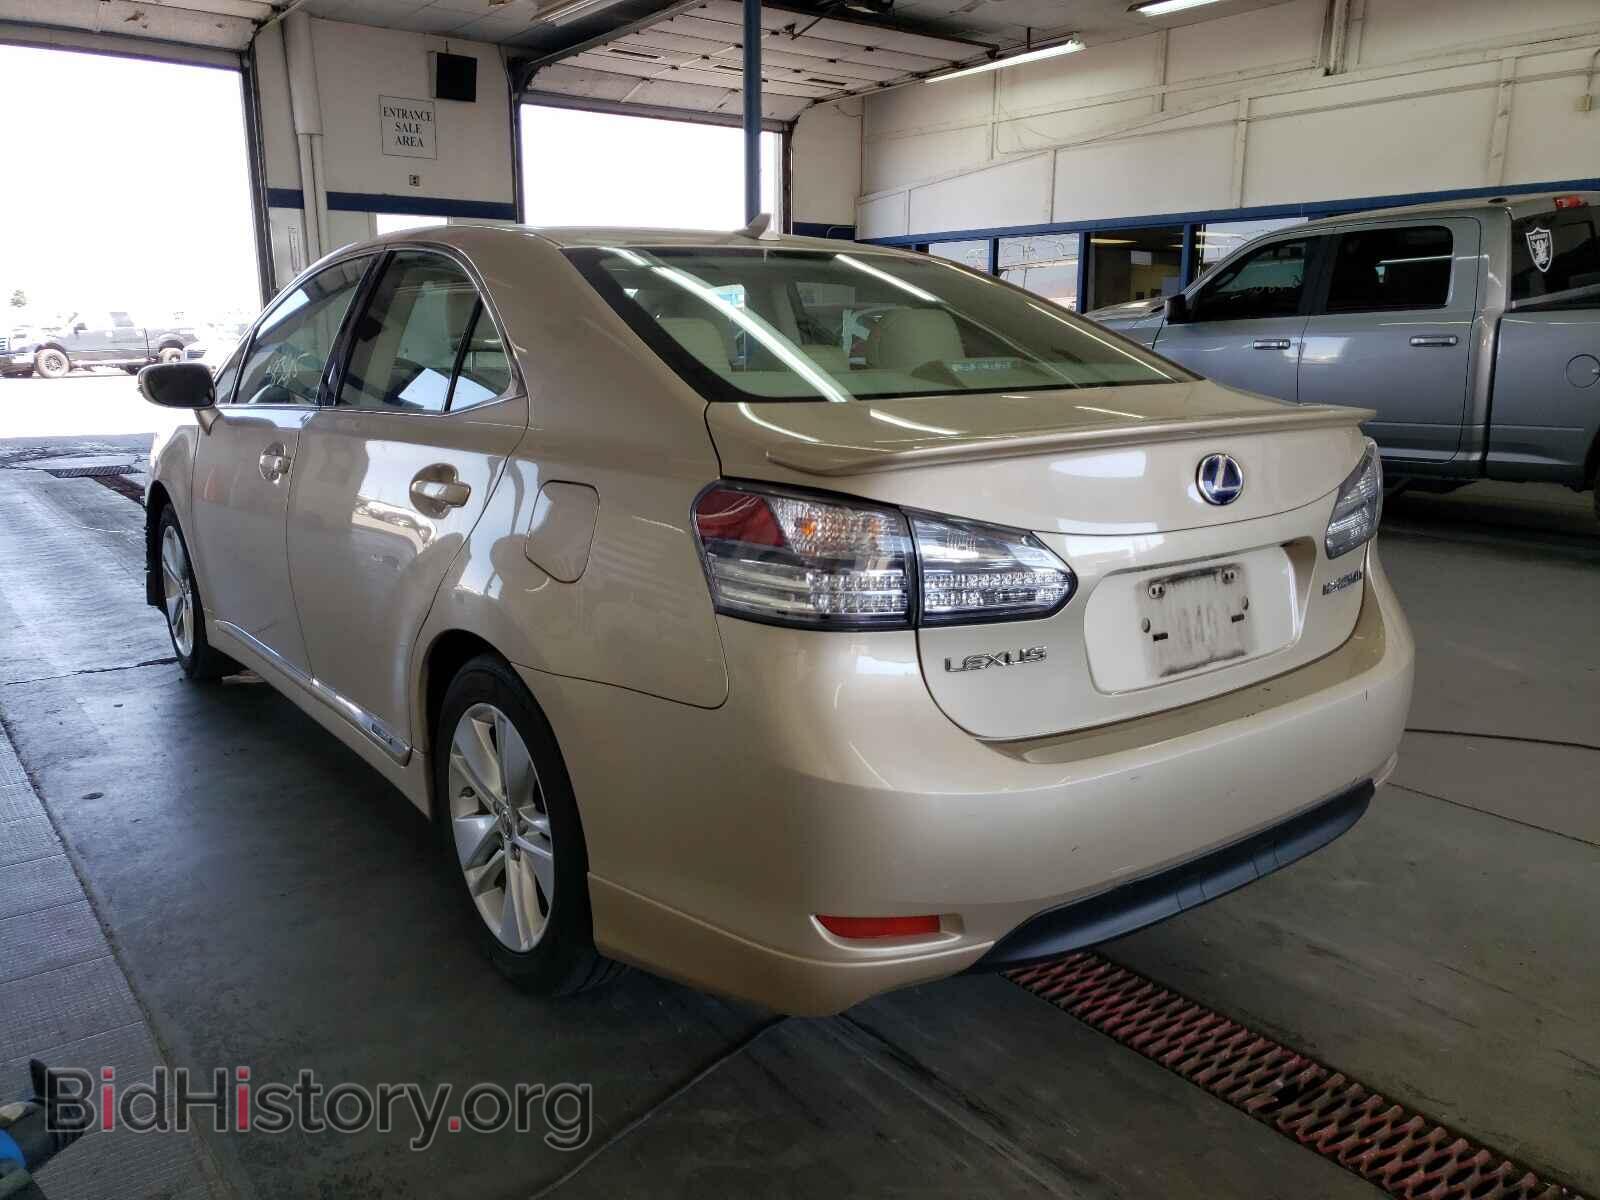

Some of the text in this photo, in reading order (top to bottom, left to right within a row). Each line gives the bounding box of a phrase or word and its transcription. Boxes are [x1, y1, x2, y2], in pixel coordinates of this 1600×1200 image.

[383, 105, 432, 122] ENTRANCE
[394, 121, 422, 134] SALE
[394, 135, 424, 148] AREA
[944, 646, 1047, 672] LEXUS
